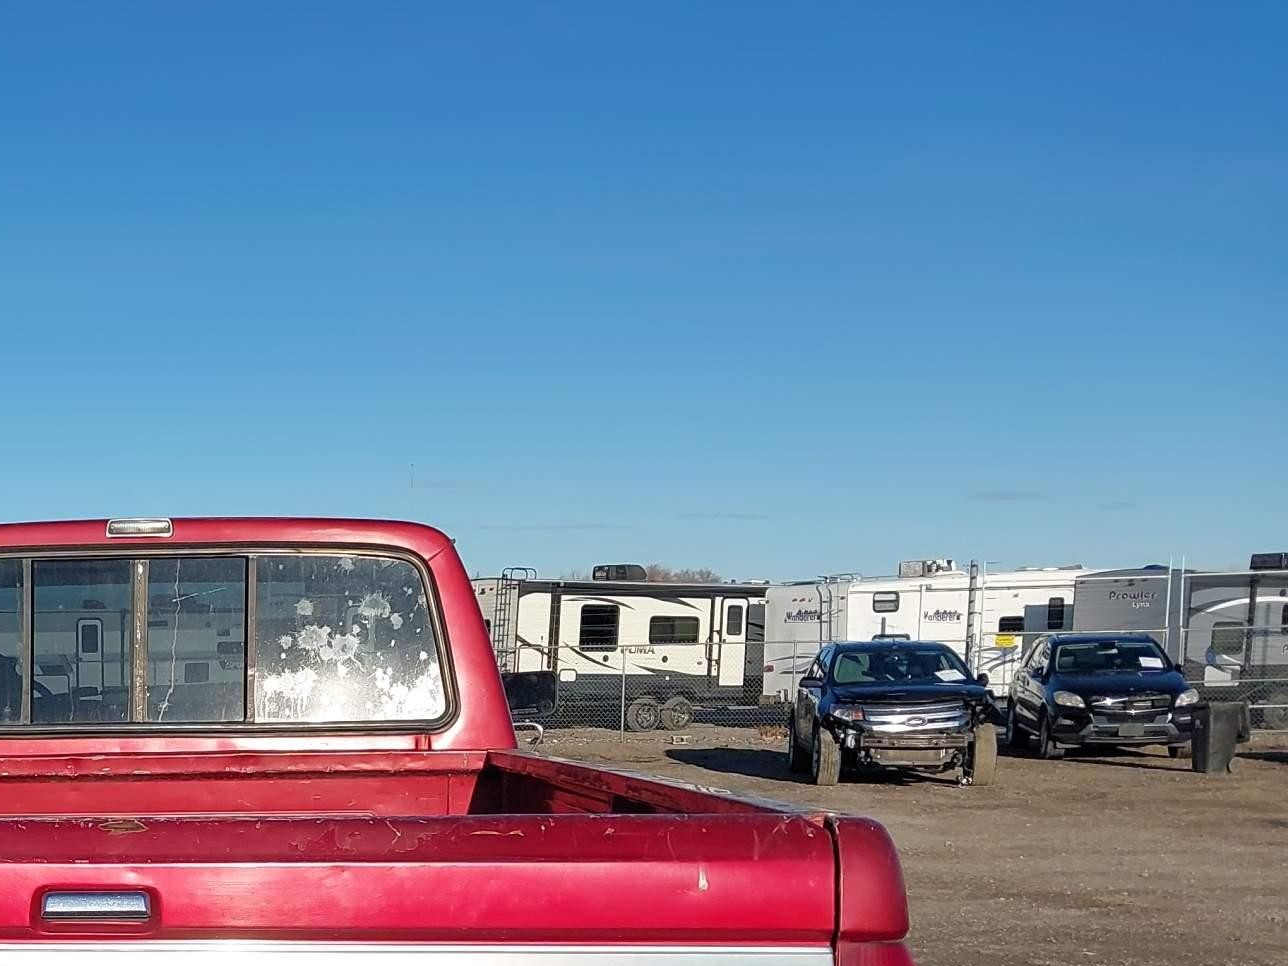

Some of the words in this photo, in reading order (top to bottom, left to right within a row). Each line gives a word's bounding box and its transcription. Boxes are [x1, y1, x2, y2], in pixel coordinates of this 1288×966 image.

[1108, 590, 1157, 600] Prowler
[1131, 601, 1151, 609] Lynx
[785, 610, 818, 622] Wanderer
[620, 645, 656, 655] PUMA
